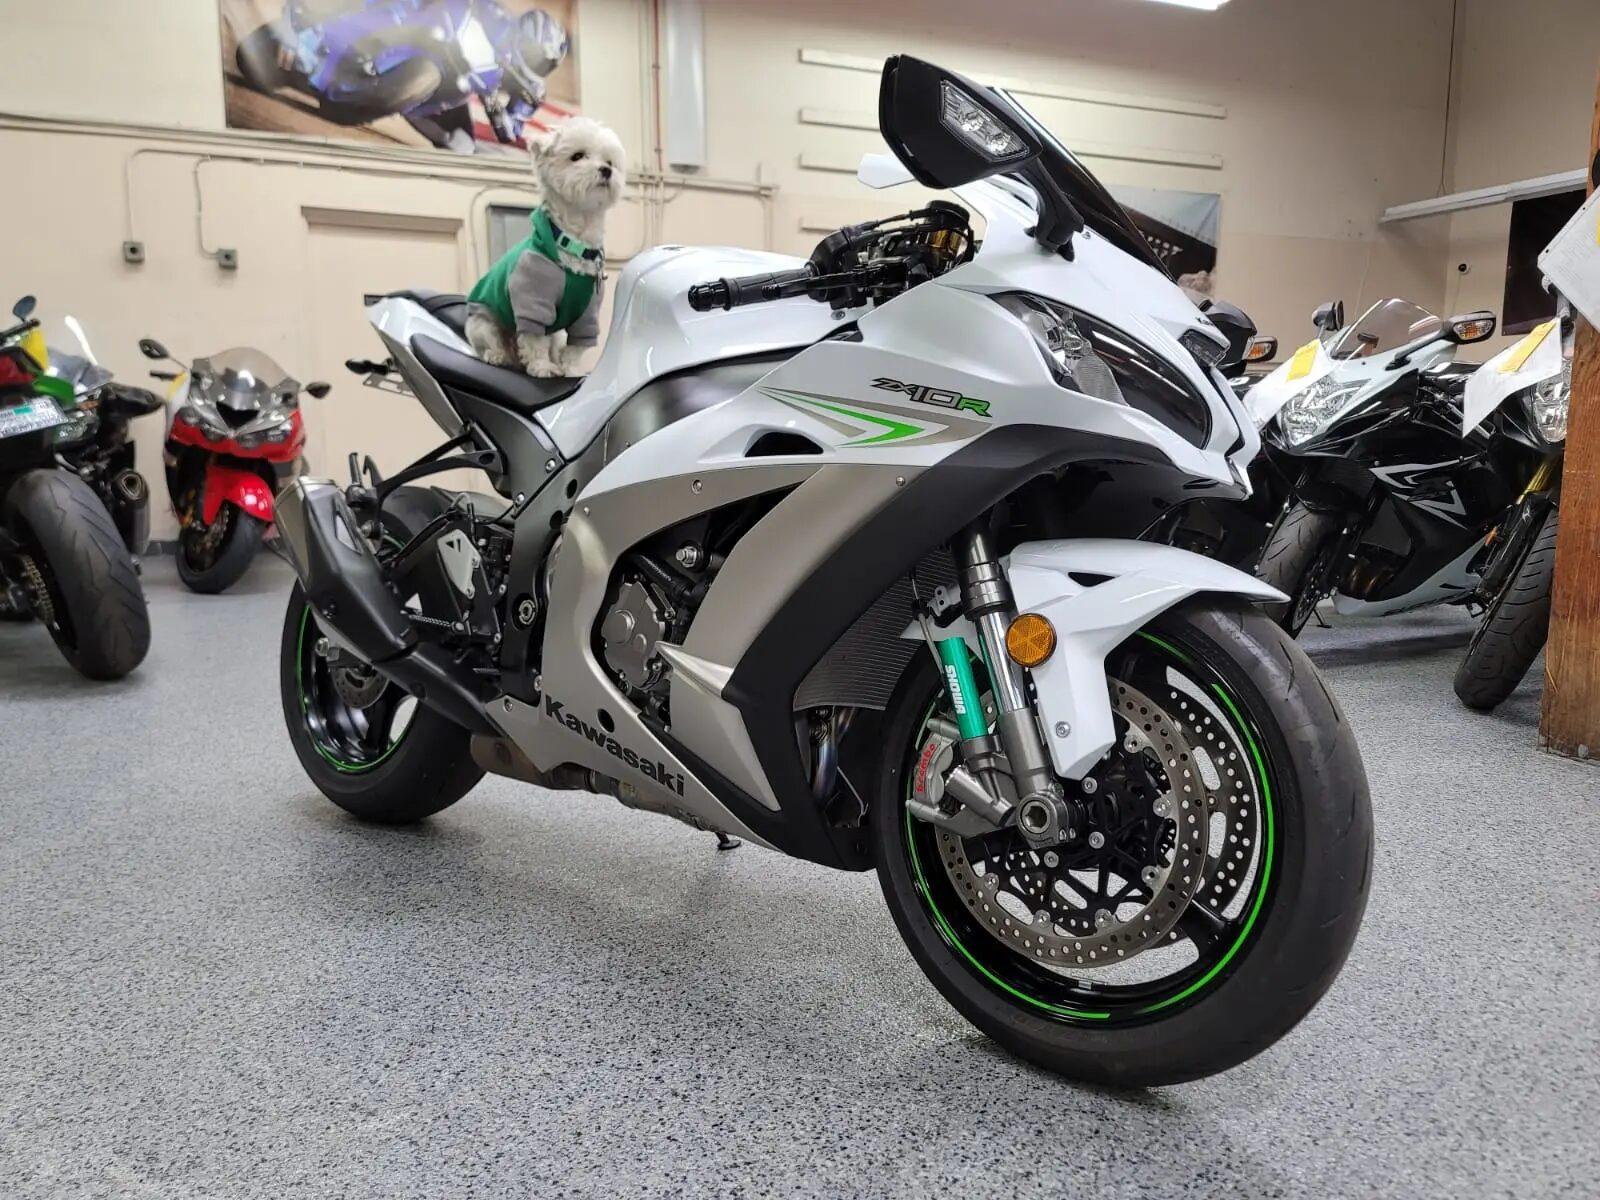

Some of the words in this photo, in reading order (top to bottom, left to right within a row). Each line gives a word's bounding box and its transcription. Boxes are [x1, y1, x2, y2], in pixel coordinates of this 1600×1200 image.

[945, 664, 966, 714] SHOWA
[545, 694, 686, 797] Kawasaki
[916, 743, 936, 793] brembo
